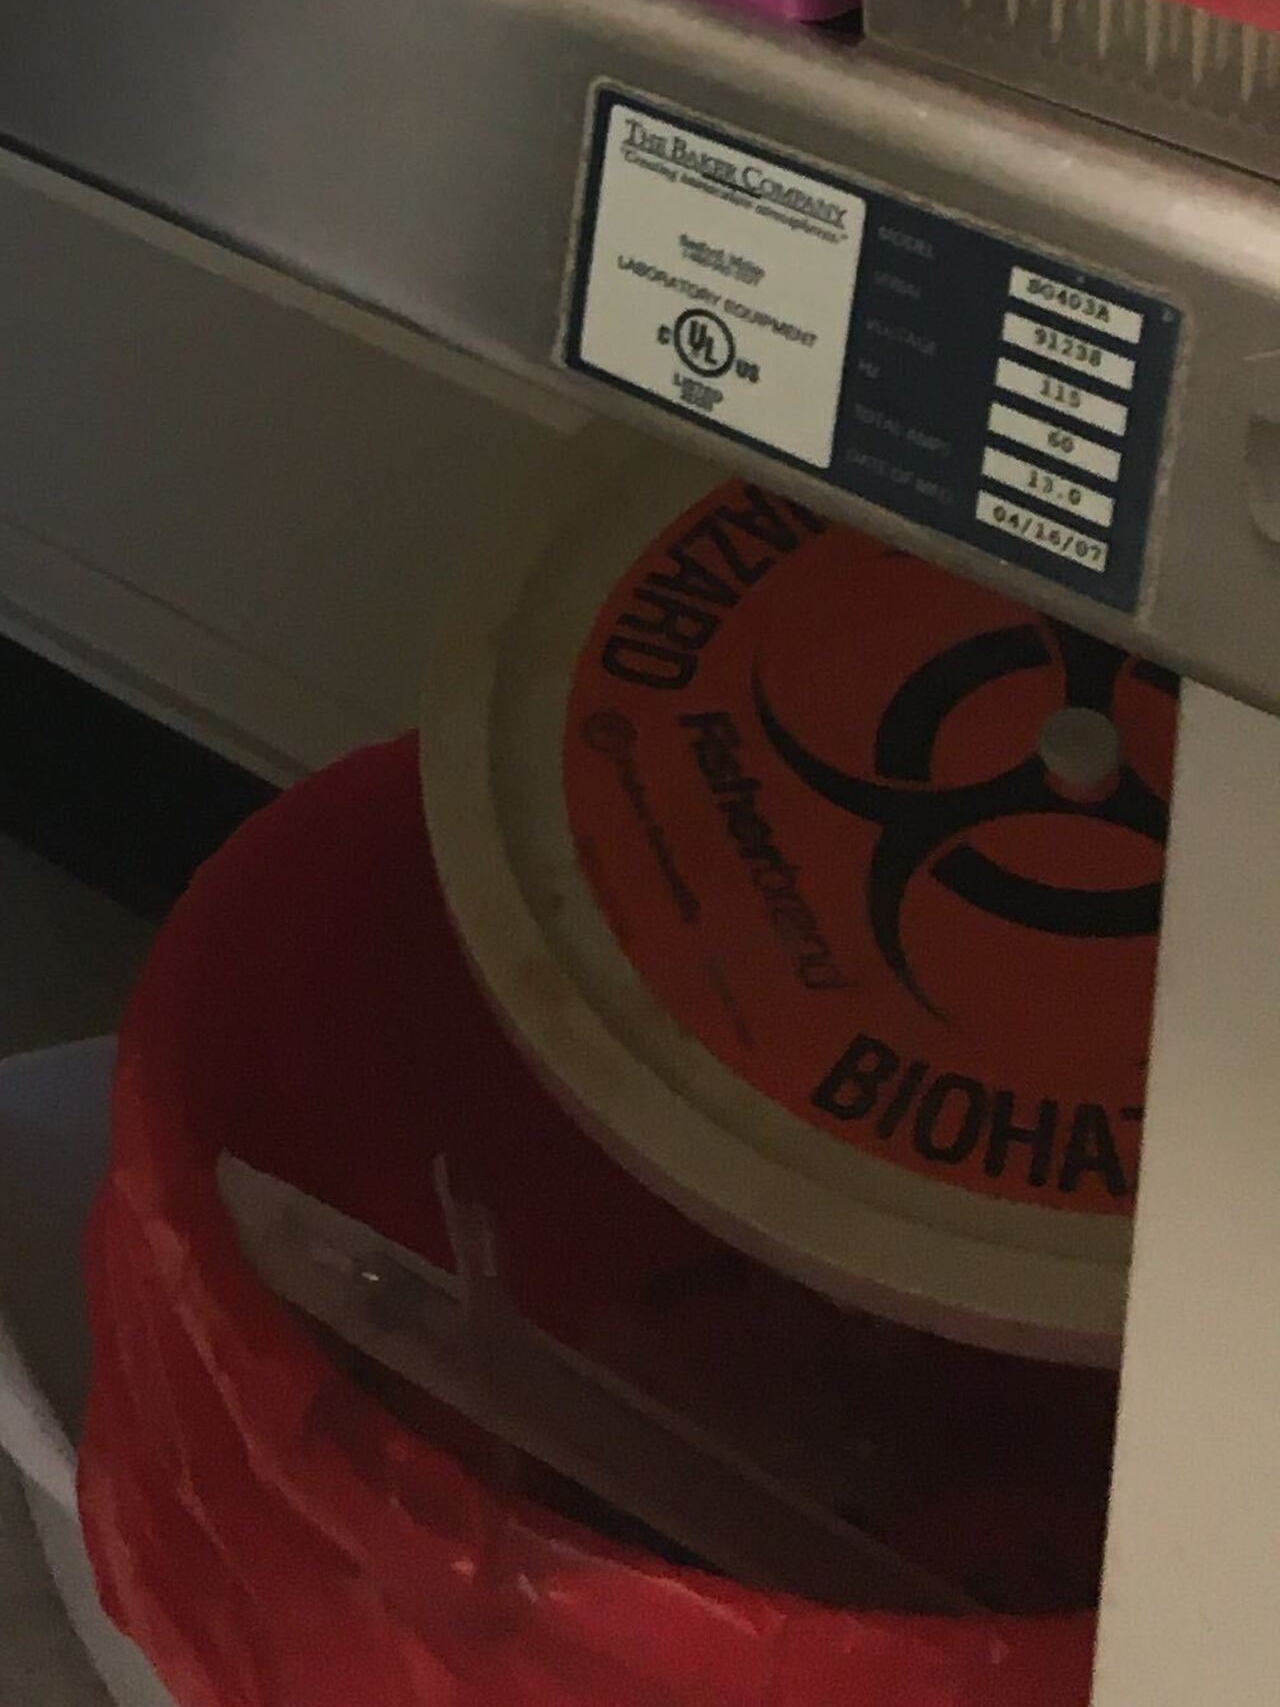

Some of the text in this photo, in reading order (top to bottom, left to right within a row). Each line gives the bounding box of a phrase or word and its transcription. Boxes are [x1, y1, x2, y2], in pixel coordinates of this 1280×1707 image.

[672, 136, 738, 183] BAKER
[742, 166, 848, 228] COMPANY
[618, 255, 722, 306] LABORATORY
[724, 298, 818, 347] EQUIPMENT
[688, 319, 718, 365] UL
[1039, 377, 1081, 409] 115
[810, 1033, 1145, 1195] BIOHA
